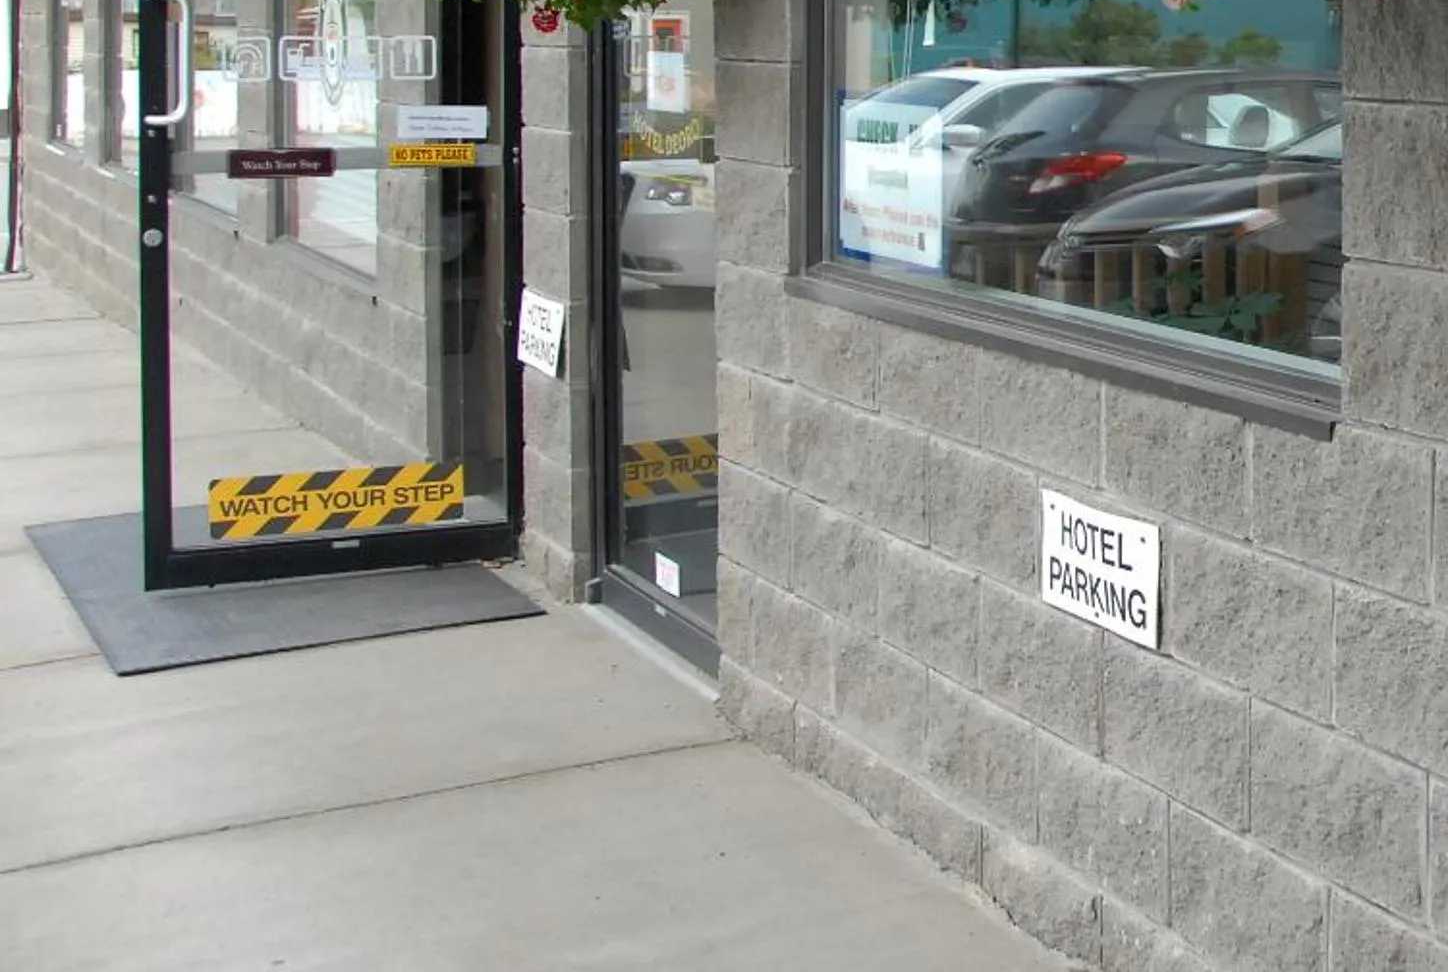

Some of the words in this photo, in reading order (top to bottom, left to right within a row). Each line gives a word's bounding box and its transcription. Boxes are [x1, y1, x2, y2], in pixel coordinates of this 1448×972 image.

[410, 149, 433, 161] PETS
[436, 149, 469, 161] PLEASE
[220, 494, 308, 517] WATCH
[316, 488, 386, 510] YOUR
[393, 483, 454, 504] STEP
[1061, 510, 1133, 572] HOTEL
[1050, 555, 1147, 629] PARKING
